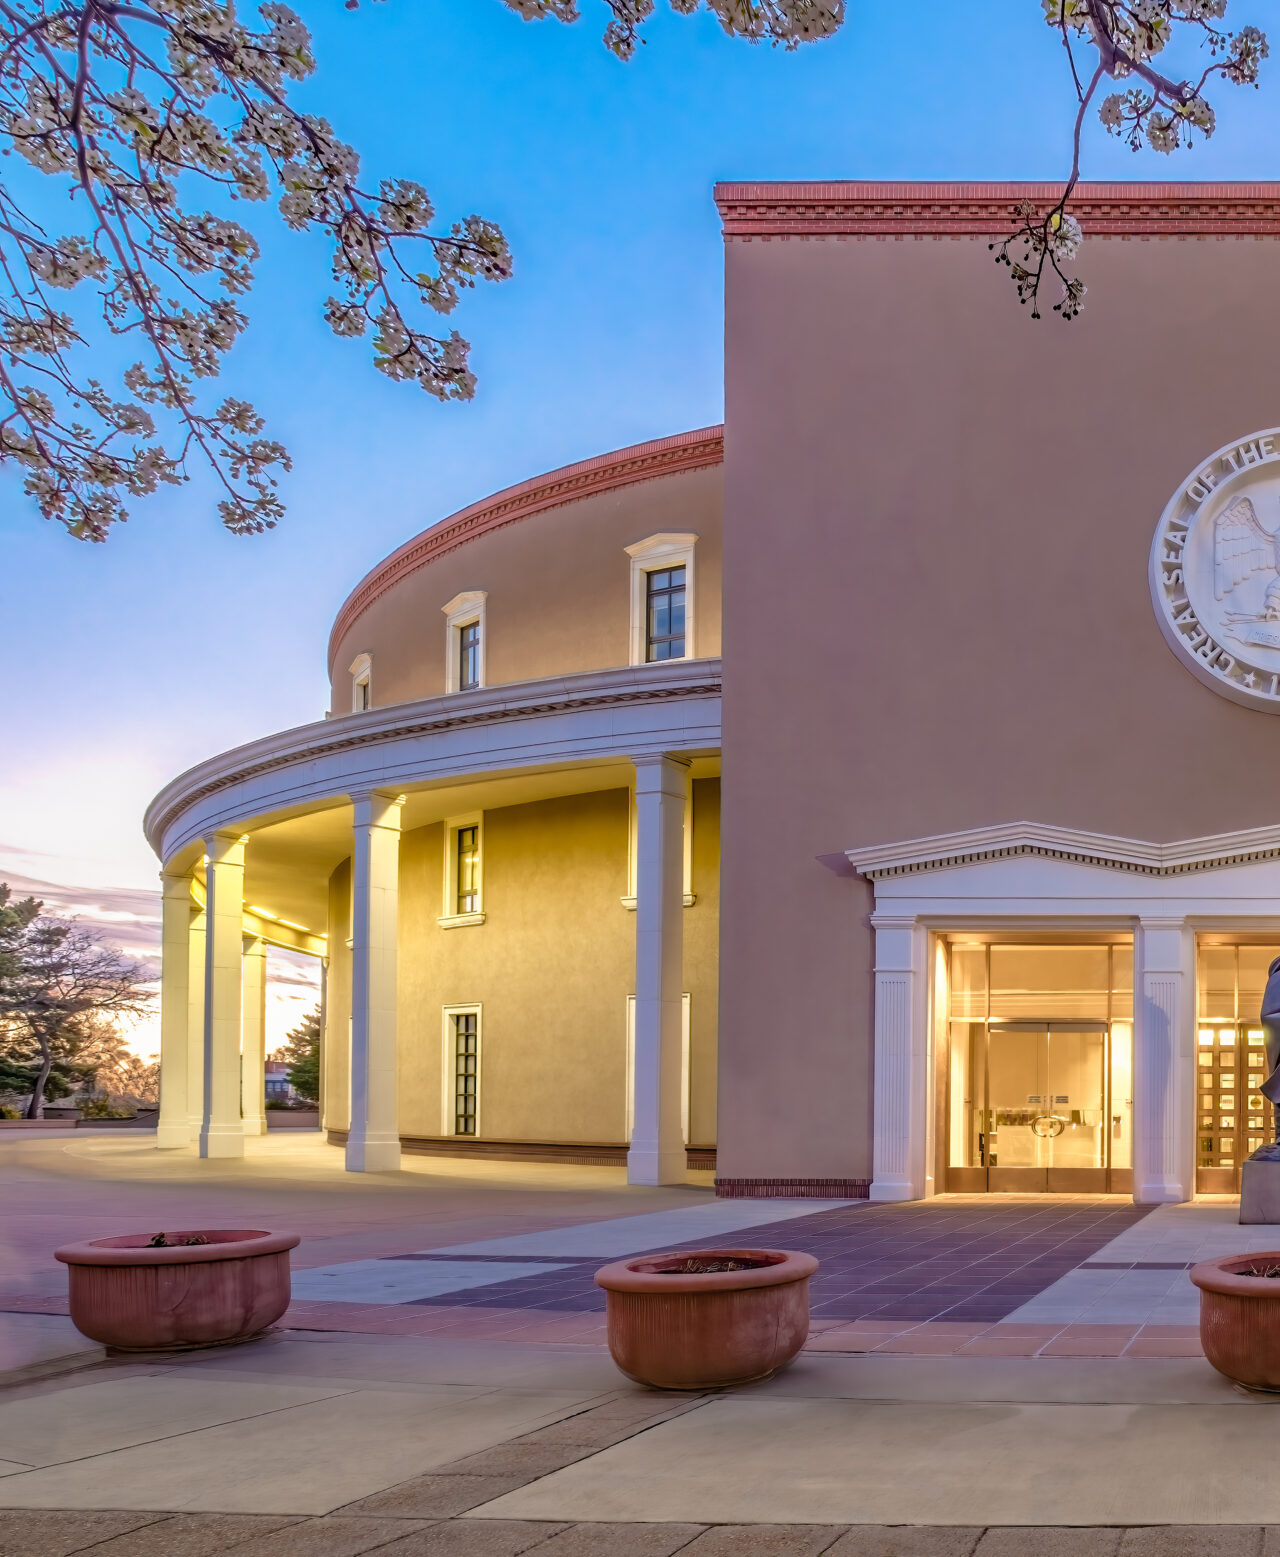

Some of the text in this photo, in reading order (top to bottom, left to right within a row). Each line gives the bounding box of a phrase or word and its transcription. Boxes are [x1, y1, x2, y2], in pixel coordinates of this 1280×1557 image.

[1221, 437, 1275, 471] THE
[1185, 467, 1218, 504] OF
[1160, 518, 1191, 586] SEAL
[1170, 598, 1236, 676] GREAT
